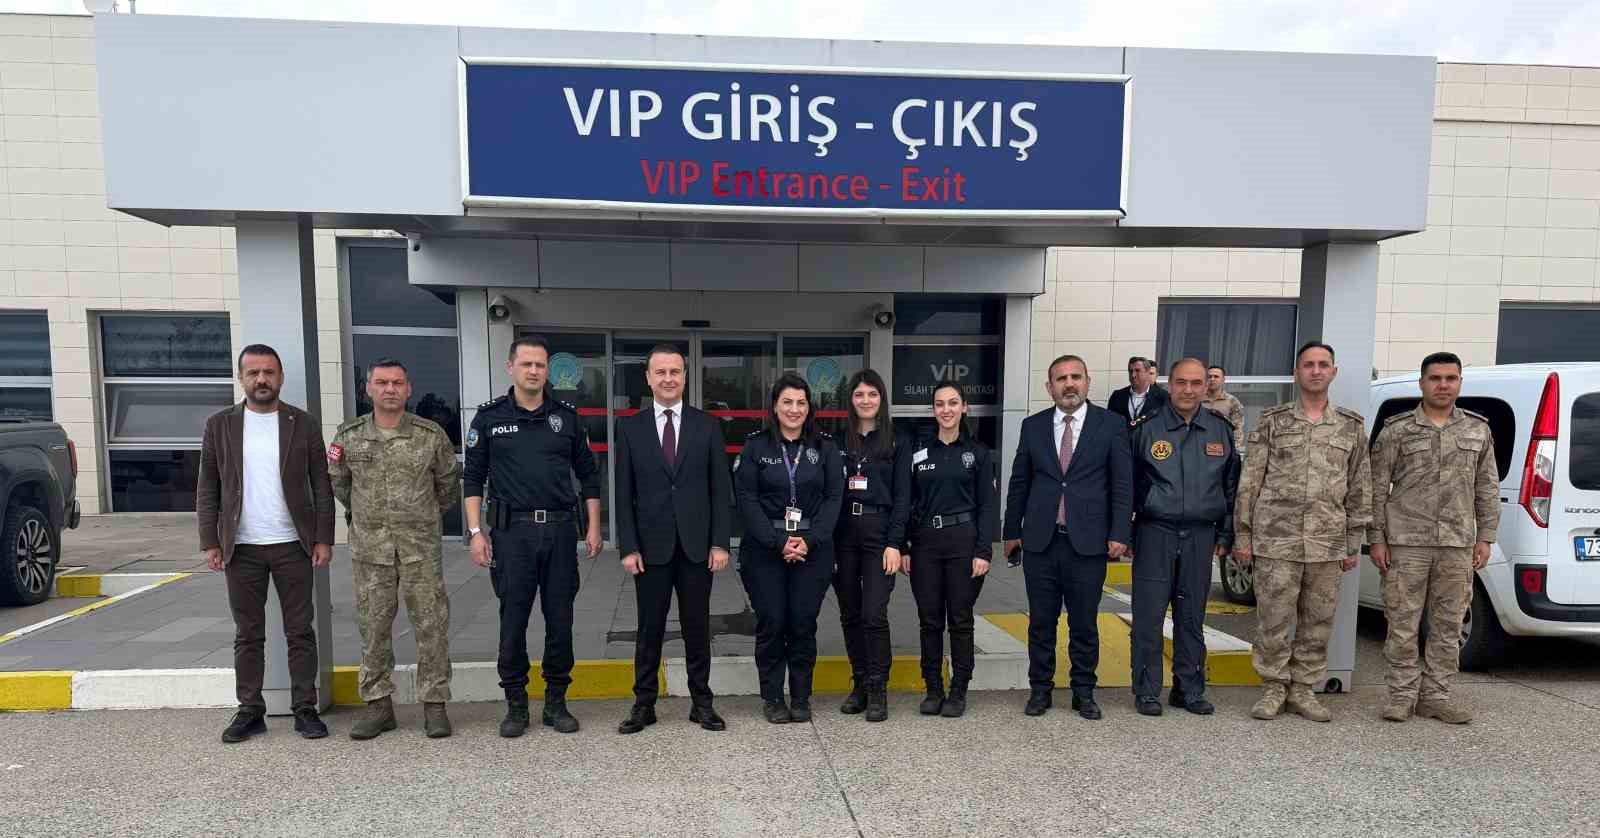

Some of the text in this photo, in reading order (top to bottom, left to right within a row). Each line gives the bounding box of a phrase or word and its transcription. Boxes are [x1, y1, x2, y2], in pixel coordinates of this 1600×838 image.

[563, 82, 1039, 161] VIP GİRİŞ - ÇIKIŞ
[640, 159, 701, 195] VIP
[710, 160, 869, 201] Entrance
[901, 166, 967, 202] Exit
